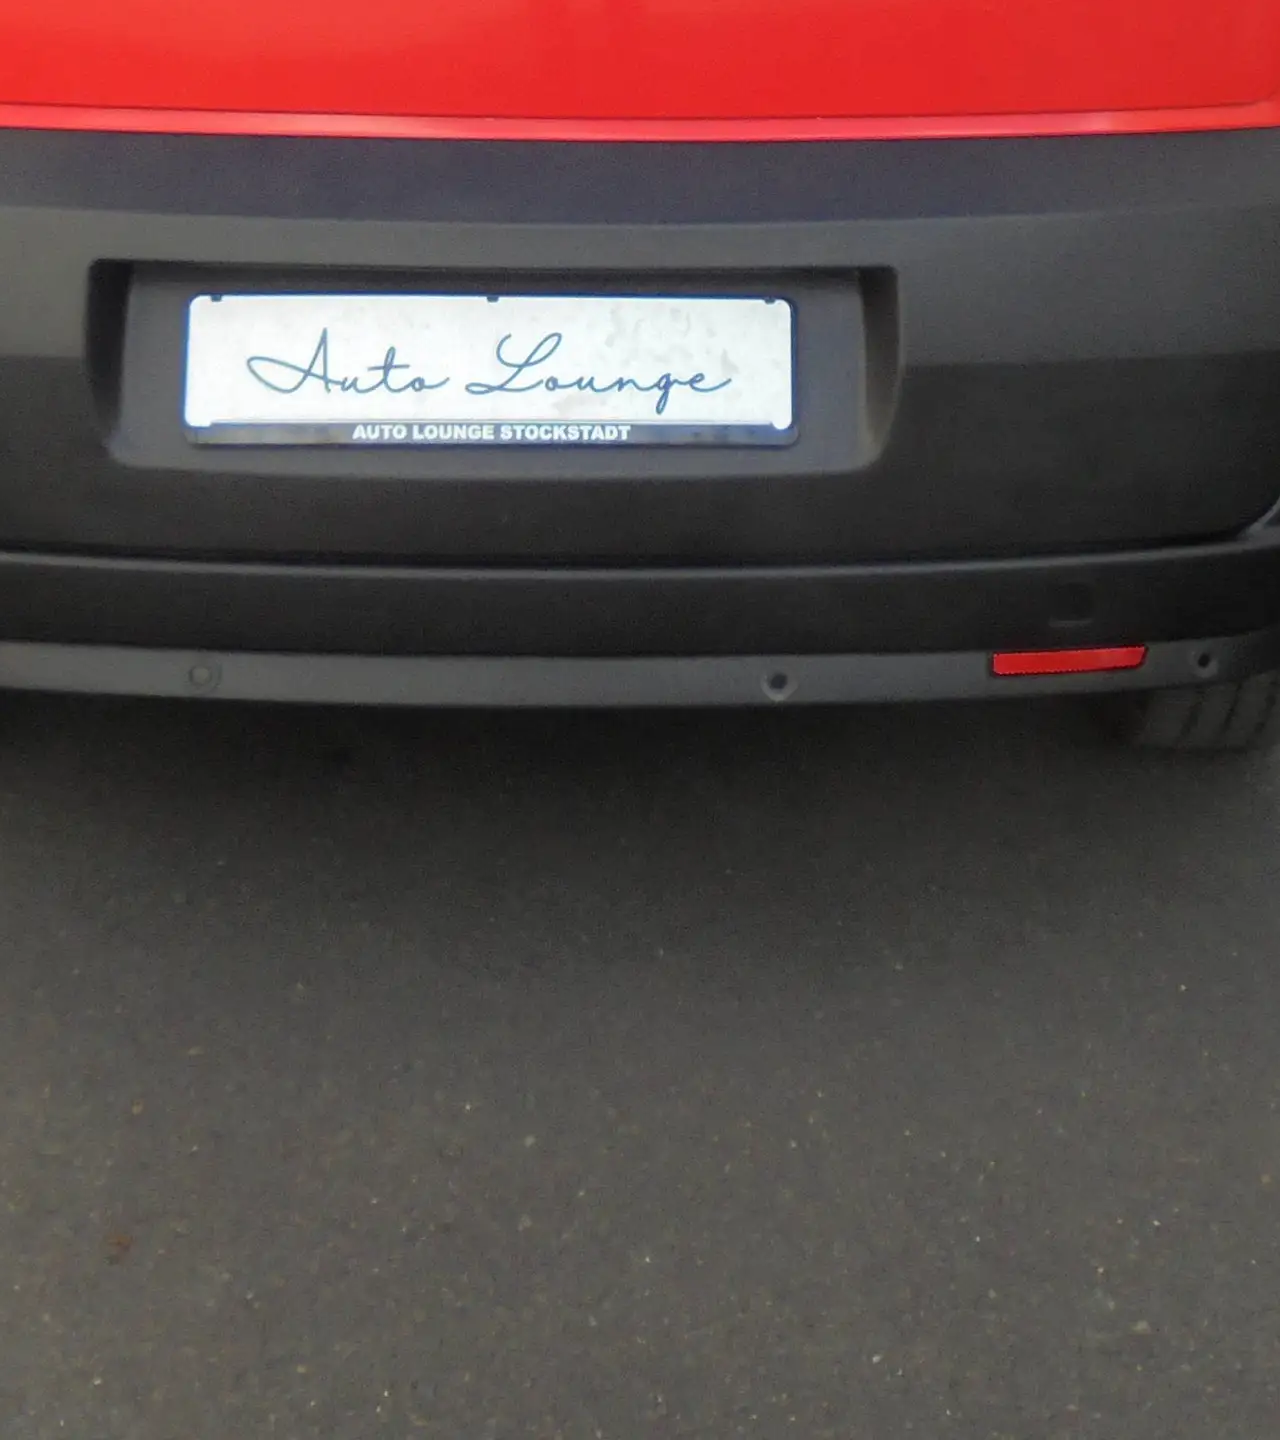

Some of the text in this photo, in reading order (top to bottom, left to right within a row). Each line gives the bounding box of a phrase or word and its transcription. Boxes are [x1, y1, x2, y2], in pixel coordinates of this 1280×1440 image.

[246, 328, 733, 415] Auto Lounge
[352, 424, 631, 441] AUTO LOUNGE STOCKSTADT
